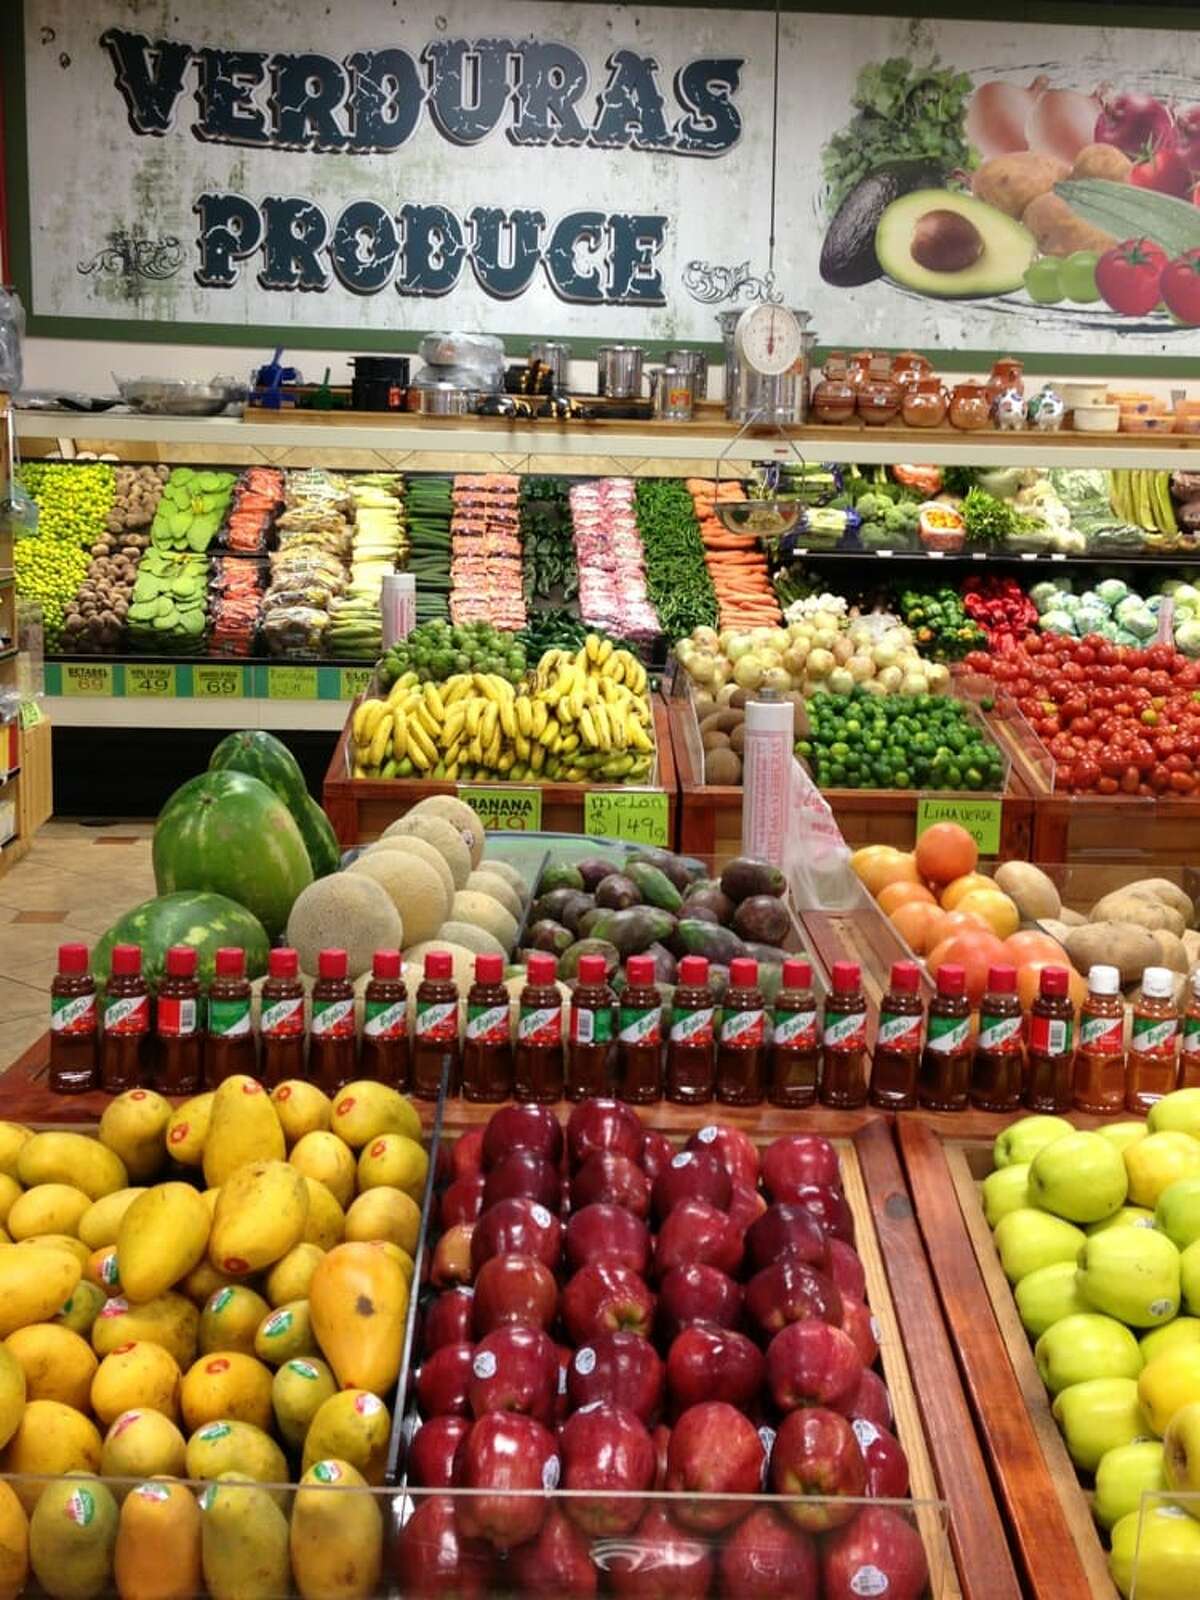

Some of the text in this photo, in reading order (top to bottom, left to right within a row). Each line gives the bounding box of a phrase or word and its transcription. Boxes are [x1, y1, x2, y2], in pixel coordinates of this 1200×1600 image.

[101, 28, 746, 157] VERDURAS
[193, 193, 668, 307] PRODUCE
[468, 797, 533, 811] BANANA
